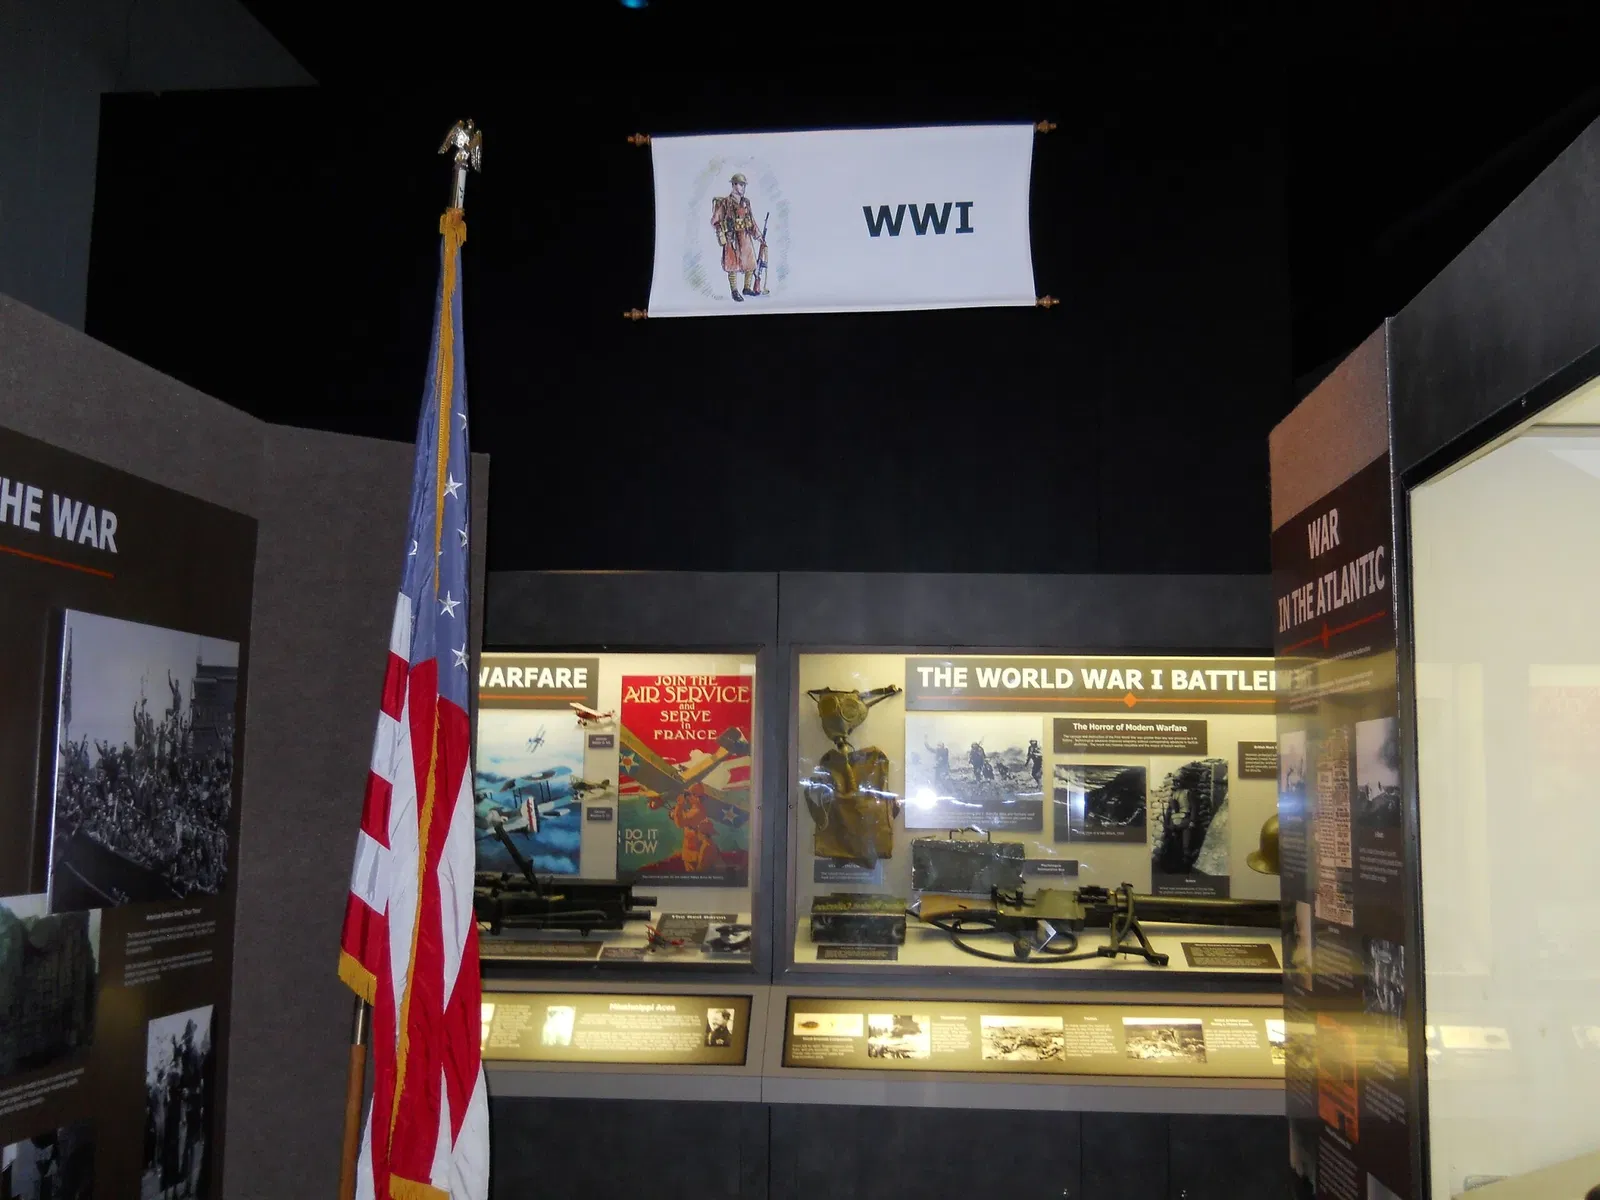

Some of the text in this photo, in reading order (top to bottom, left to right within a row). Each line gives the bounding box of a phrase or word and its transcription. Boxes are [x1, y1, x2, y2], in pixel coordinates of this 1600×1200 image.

[862, 201, 974, 237] WWI
[0, 476, 118, 554] HE WAR
[1308, 508, 1341, 559] WAR
[1278, 545, 1385, 633] IN THE ATLANTIC
[654, 675, 718, 686] JOIN THE
[917, 666, 968, 688] THE
[975, 667, 1074, 689] WORLD
[1080, 668, 1144, 690] WAR
[1151, 669, 1163, 690] I
[623, 686, 750, 703] AIR SERVICE
[679, 702, 695, 710] and
[660, 710, 712, 722] SERVE
[681, 721, 691, 729] in
[1072, 722, 1188, 732] The Horror of Modern Warfare
[654, 729, 717, 740] FRANCE
[625, 829, 658, 840] DO IT
[625, 840, 658, 854] NOW
